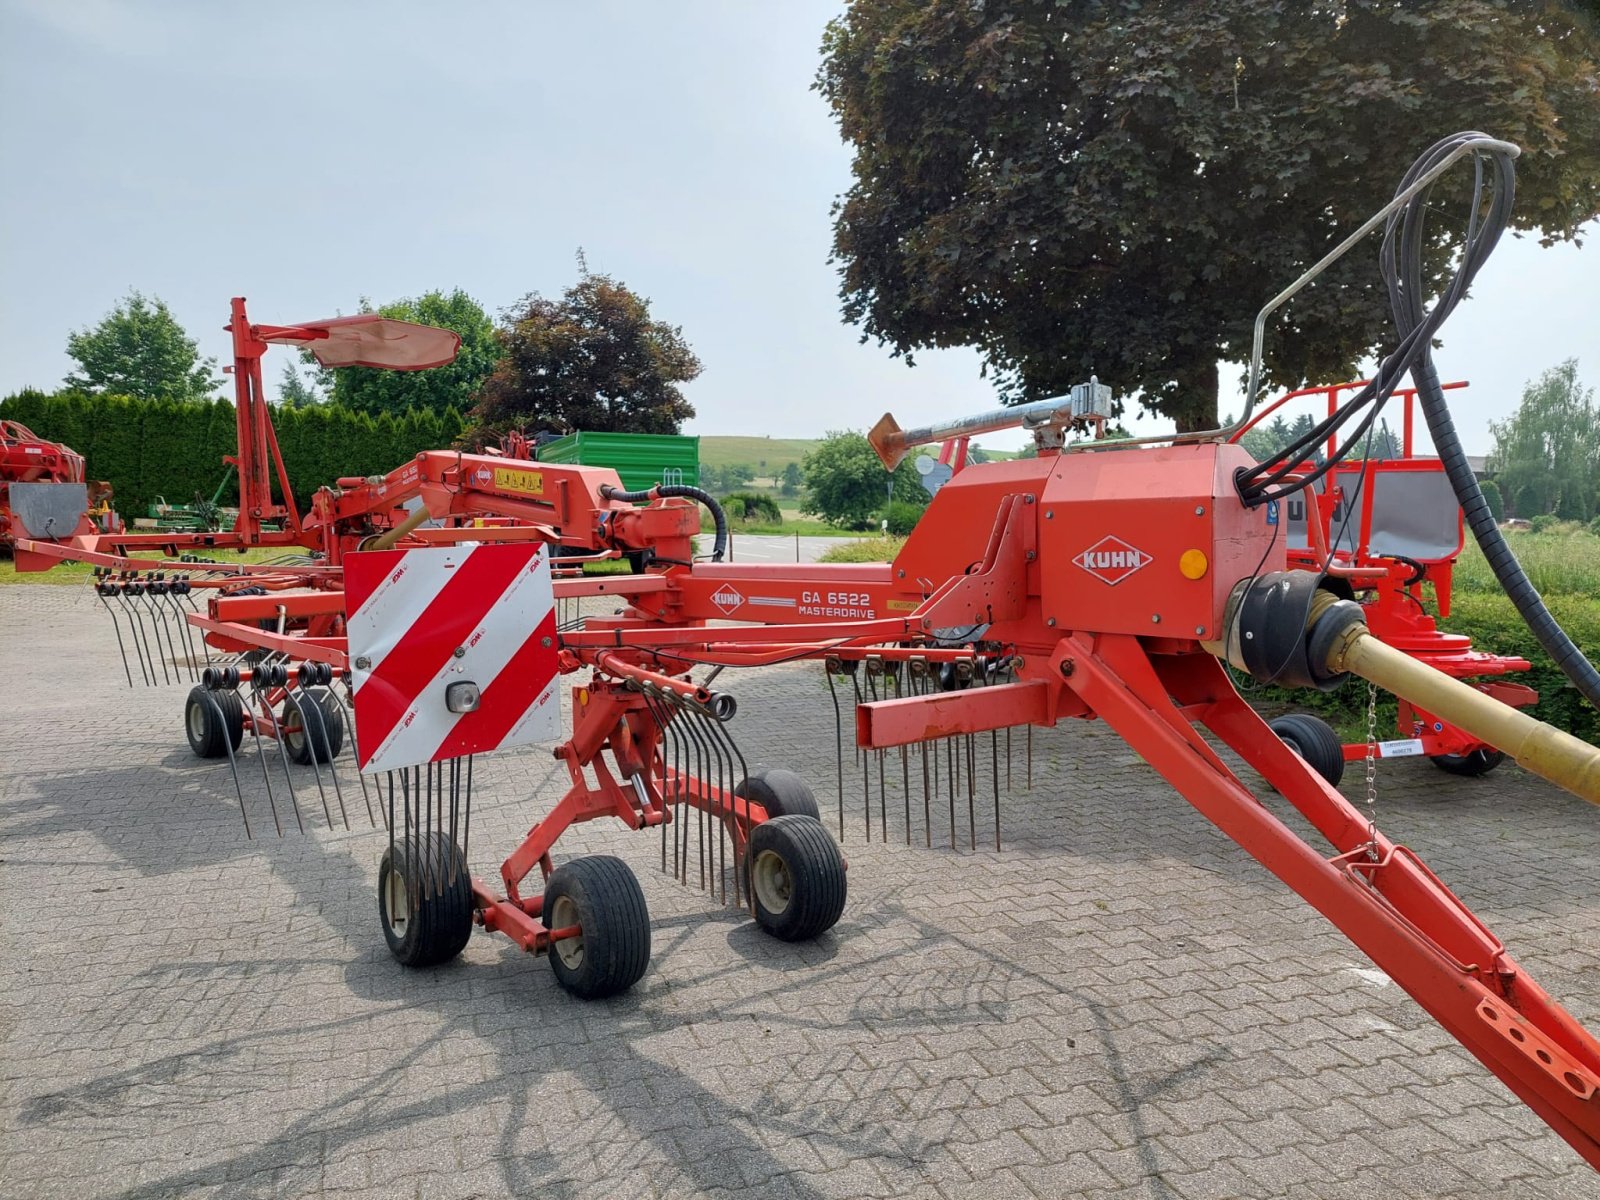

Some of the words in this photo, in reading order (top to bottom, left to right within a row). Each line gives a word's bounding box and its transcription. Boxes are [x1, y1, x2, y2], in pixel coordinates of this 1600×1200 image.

[1083, 551, 1141, 568] KUHN
[715, 593, 741, 605] KUHN
[802, 591, 821, 604] GA
[828, 593, 870, 606] 6522
[798, 606, 875, 619] MASTERDRIVE
